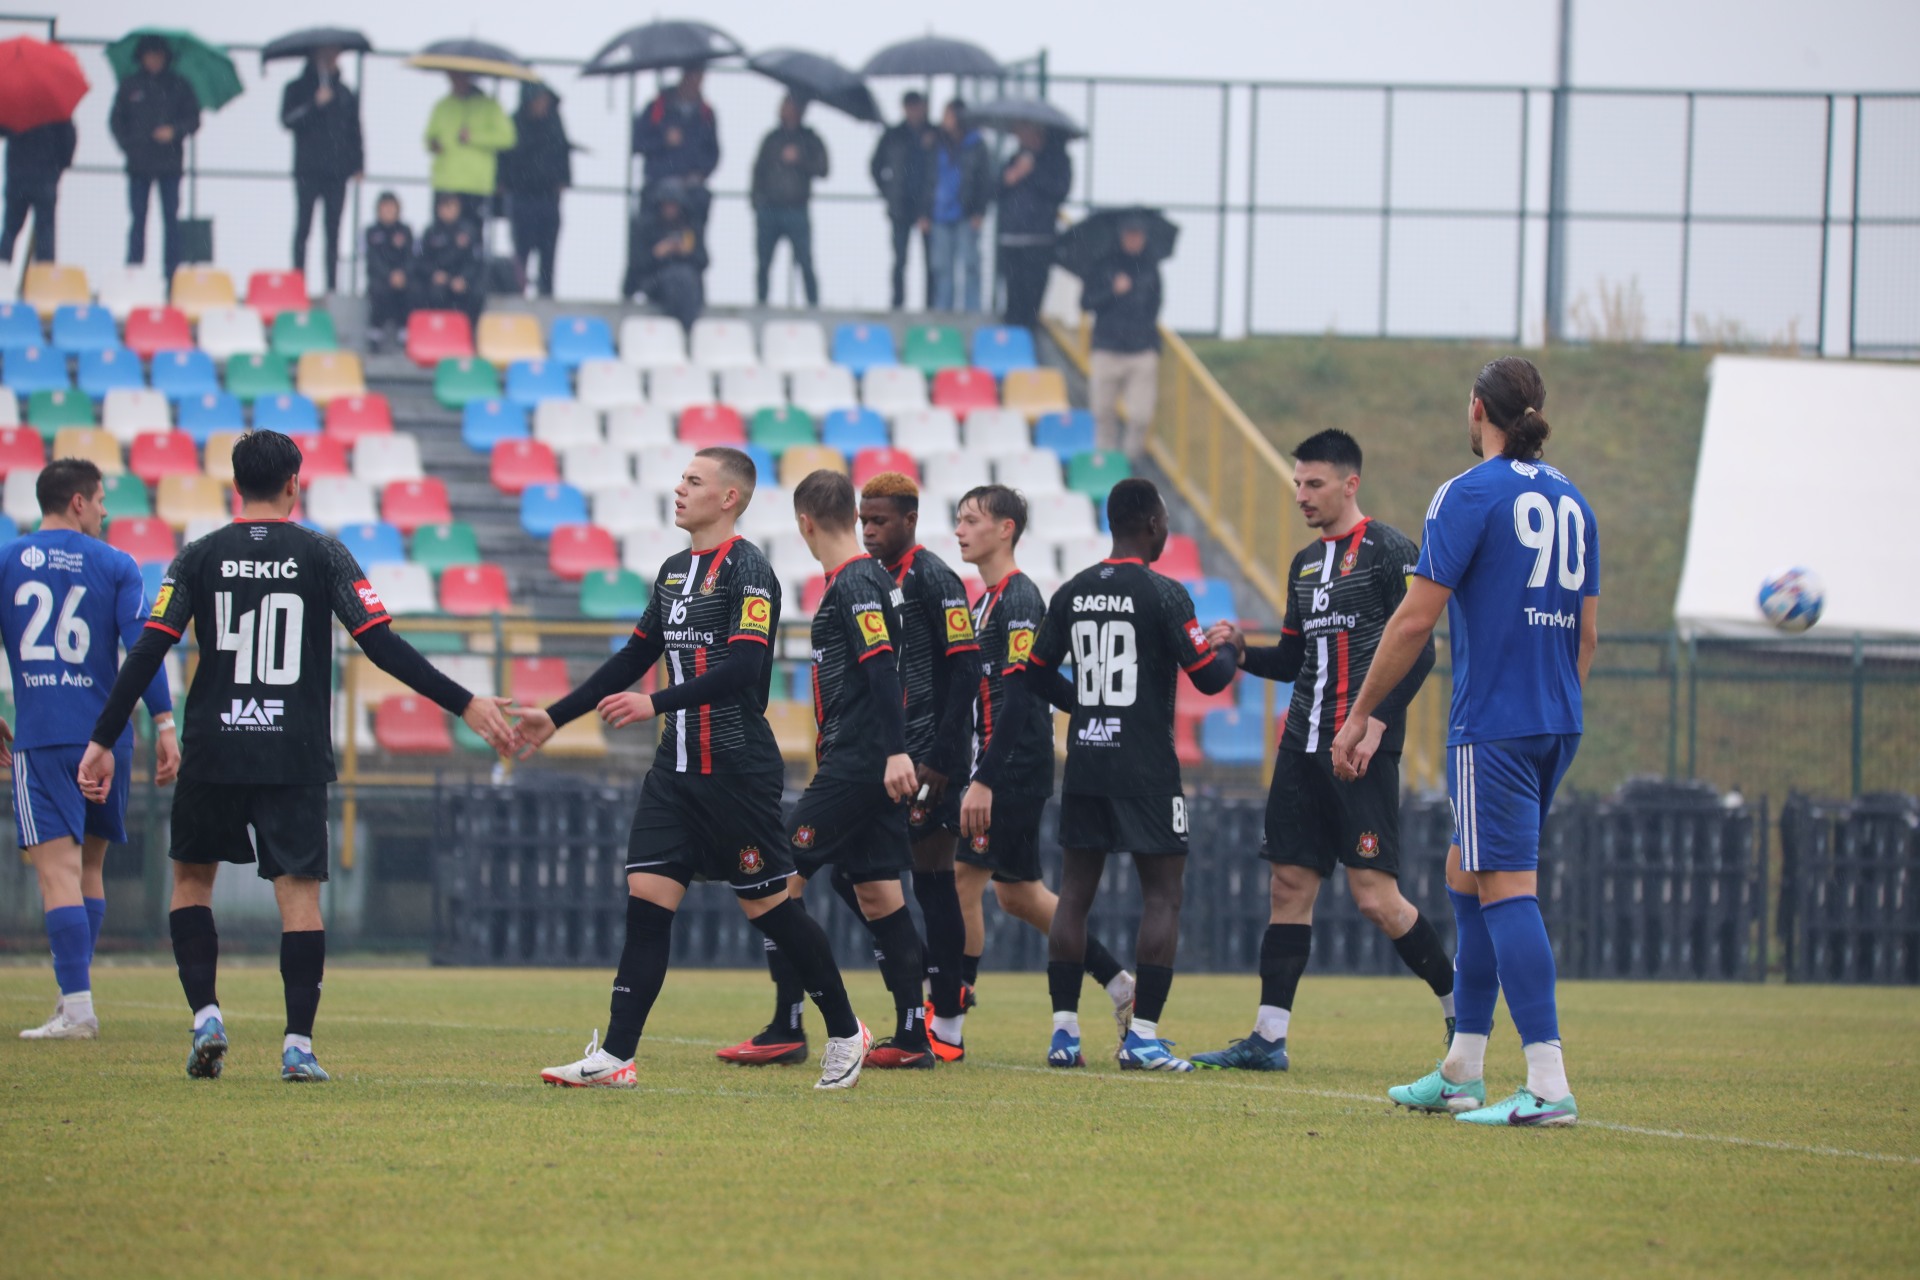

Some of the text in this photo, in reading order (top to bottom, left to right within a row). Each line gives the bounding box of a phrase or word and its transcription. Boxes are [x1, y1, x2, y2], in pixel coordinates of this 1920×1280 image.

[220, 557, 299, 579] ĐEKIĆ
[1513, 491, 1585, 591] 90
[15, 581, 90, 664] 26
[1072, 595, 1135, 613] SAGNA
[215, 591, 305, 685] 40
[1070, 620, 1138, 707] 88
[220, 696, 285, 726] JAF
[1078, 717, 1121, 742] JAF
